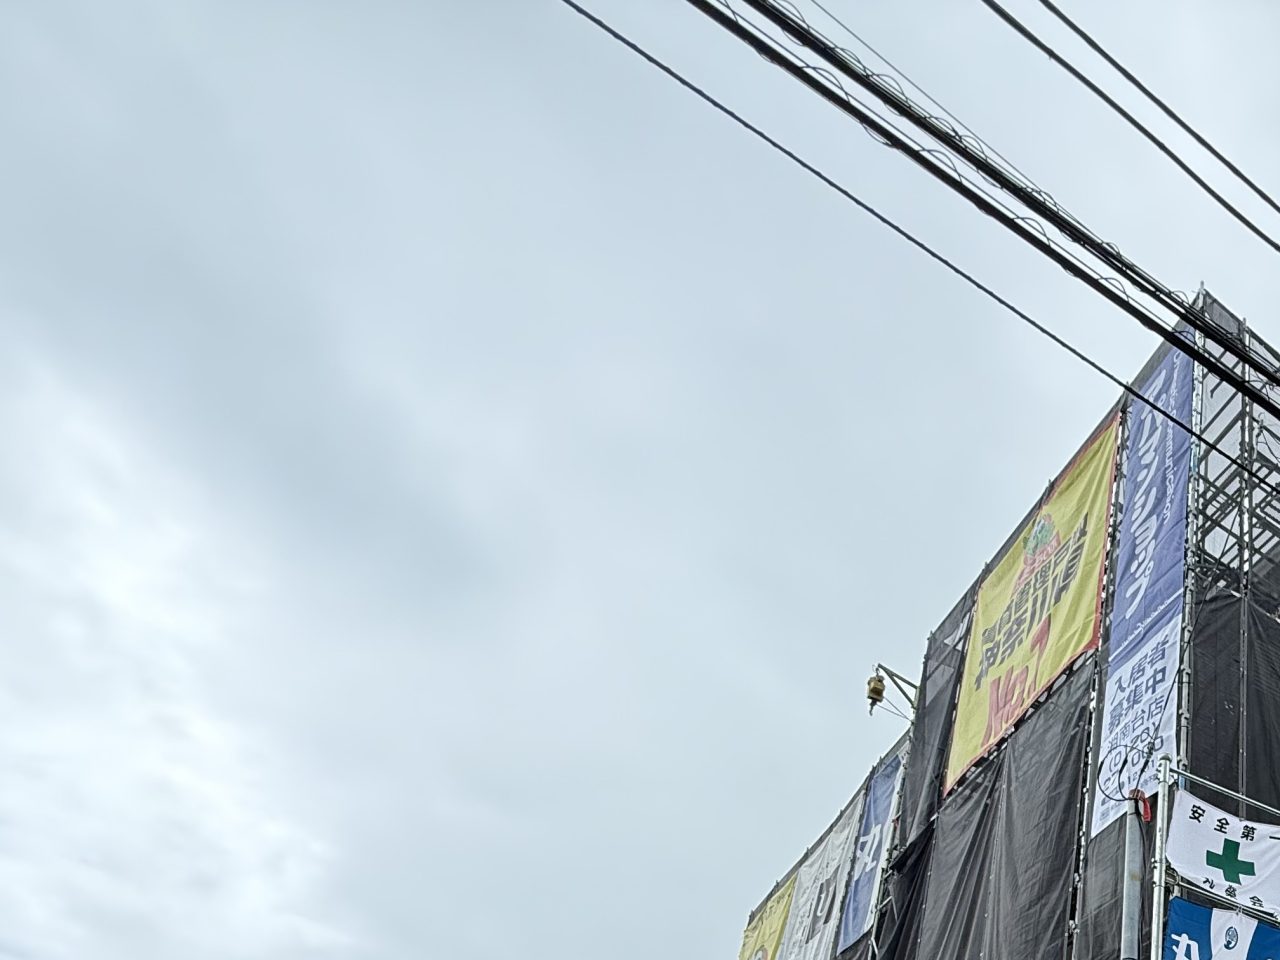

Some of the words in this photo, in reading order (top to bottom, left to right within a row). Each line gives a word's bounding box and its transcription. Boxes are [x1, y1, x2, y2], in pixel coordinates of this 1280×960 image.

[1107, 665, 1167, 736] 募集中
[1110, 634, 1169, 706] 入居者
